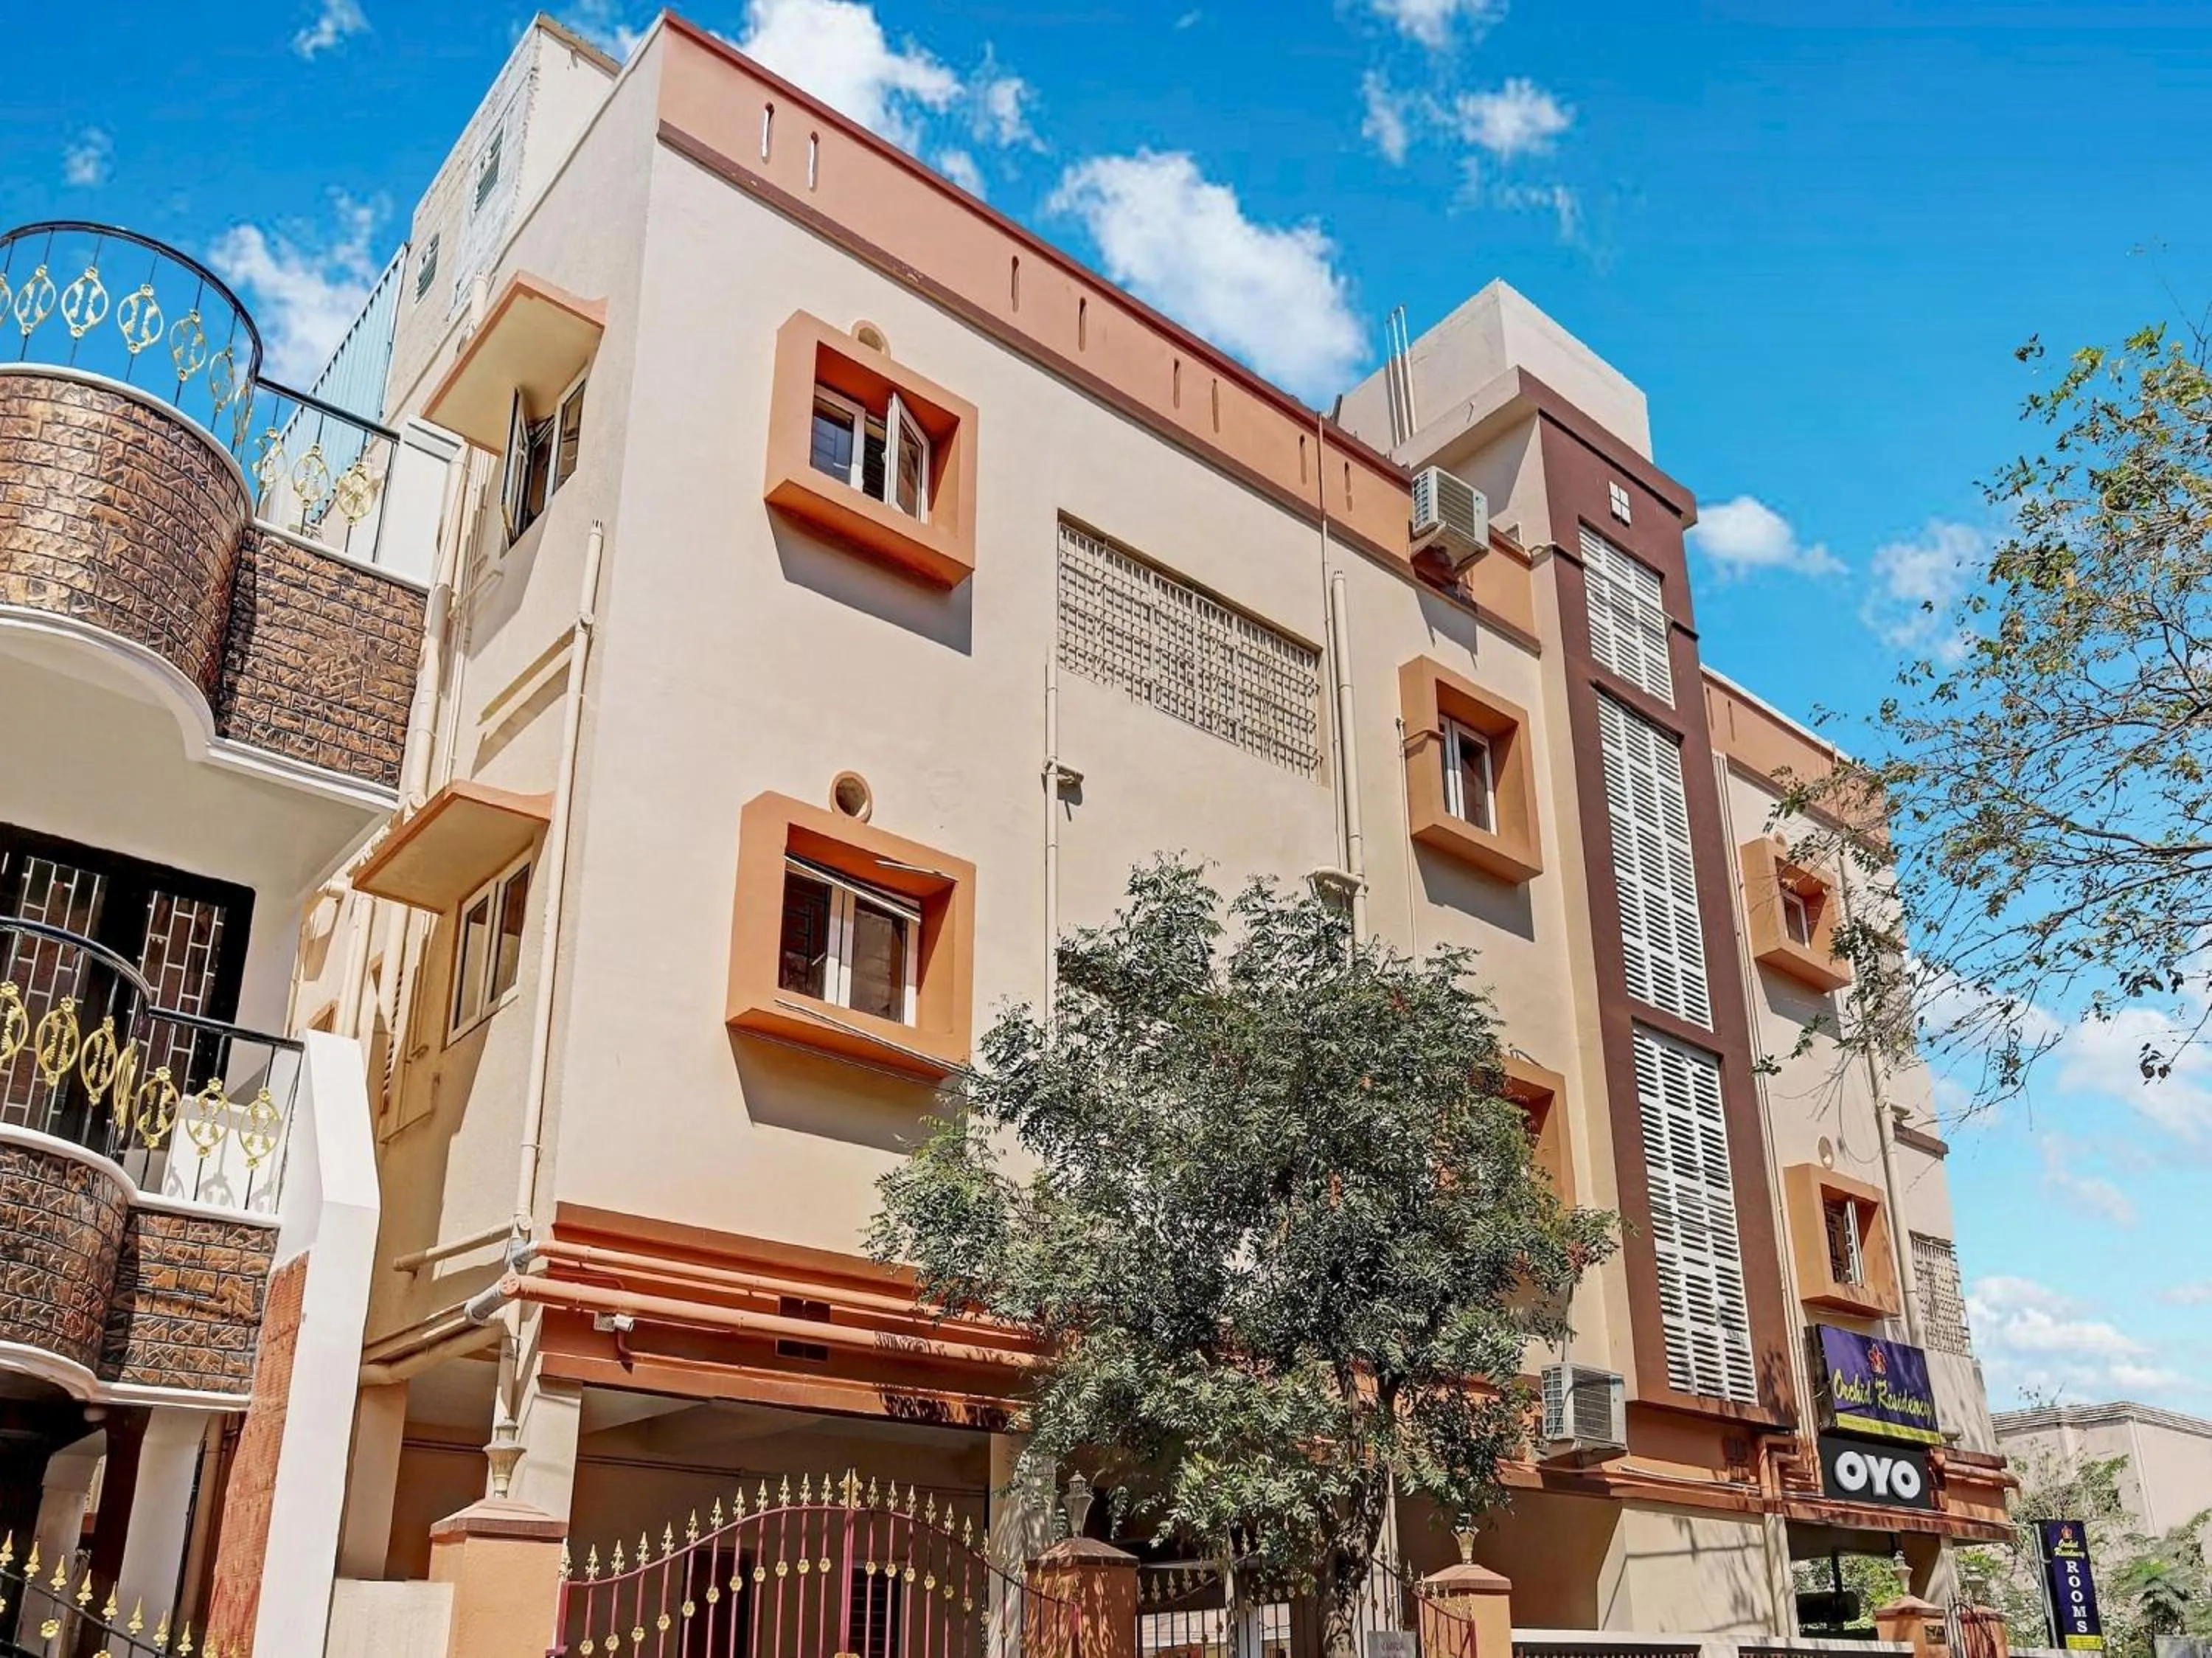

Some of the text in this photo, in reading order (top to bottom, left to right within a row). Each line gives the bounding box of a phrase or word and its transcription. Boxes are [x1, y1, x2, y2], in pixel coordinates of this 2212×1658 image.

[1834, 1369, 1932, 1425] Orchid Residency
[1834, 1451, 1921, 1499] OYO
[2065, 1560, 2088, 1633] ROOMS
